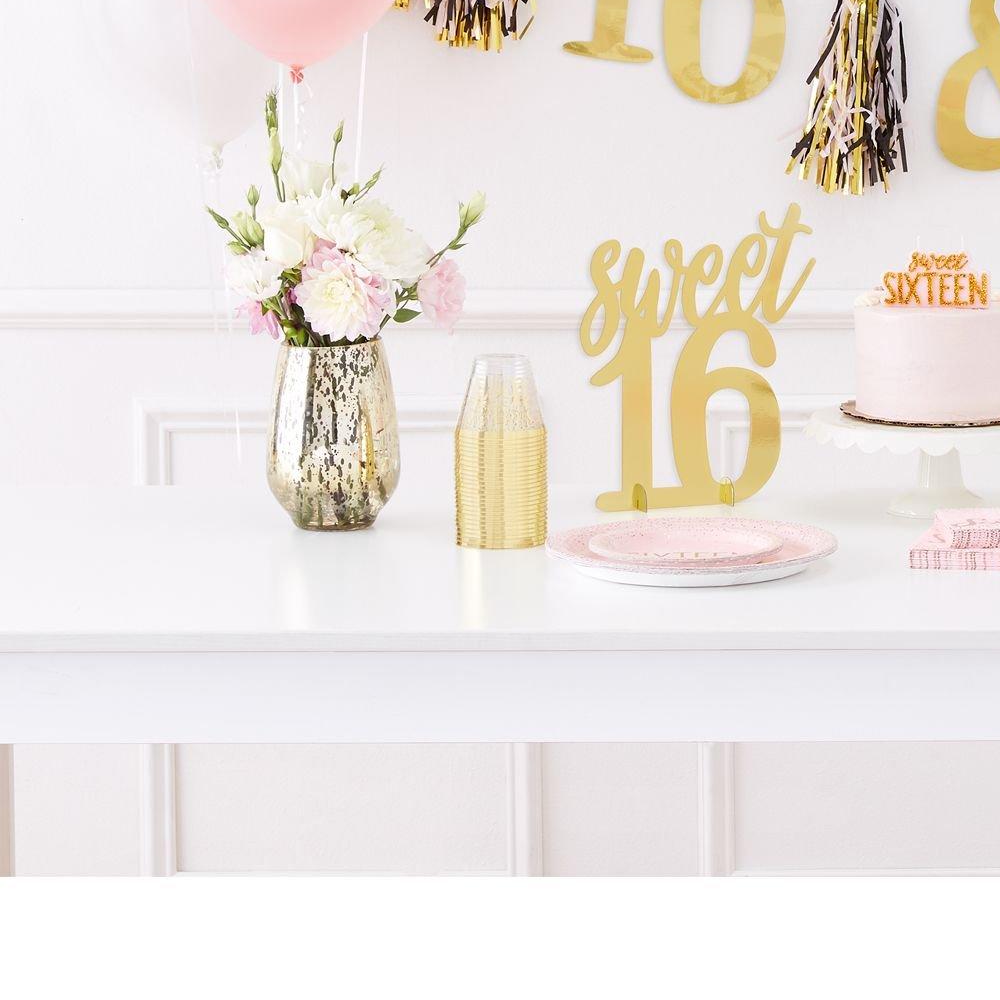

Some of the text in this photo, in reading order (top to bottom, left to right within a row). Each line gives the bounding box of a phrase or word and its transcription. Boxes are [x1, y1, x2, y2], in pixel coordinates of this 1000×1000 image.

[579, 202, 817, 356] sweet
[883, 271, 989, 306] SIXTEEN
[908, 250, 969, 273] sweet
[589, 309, 781, 512] 16
